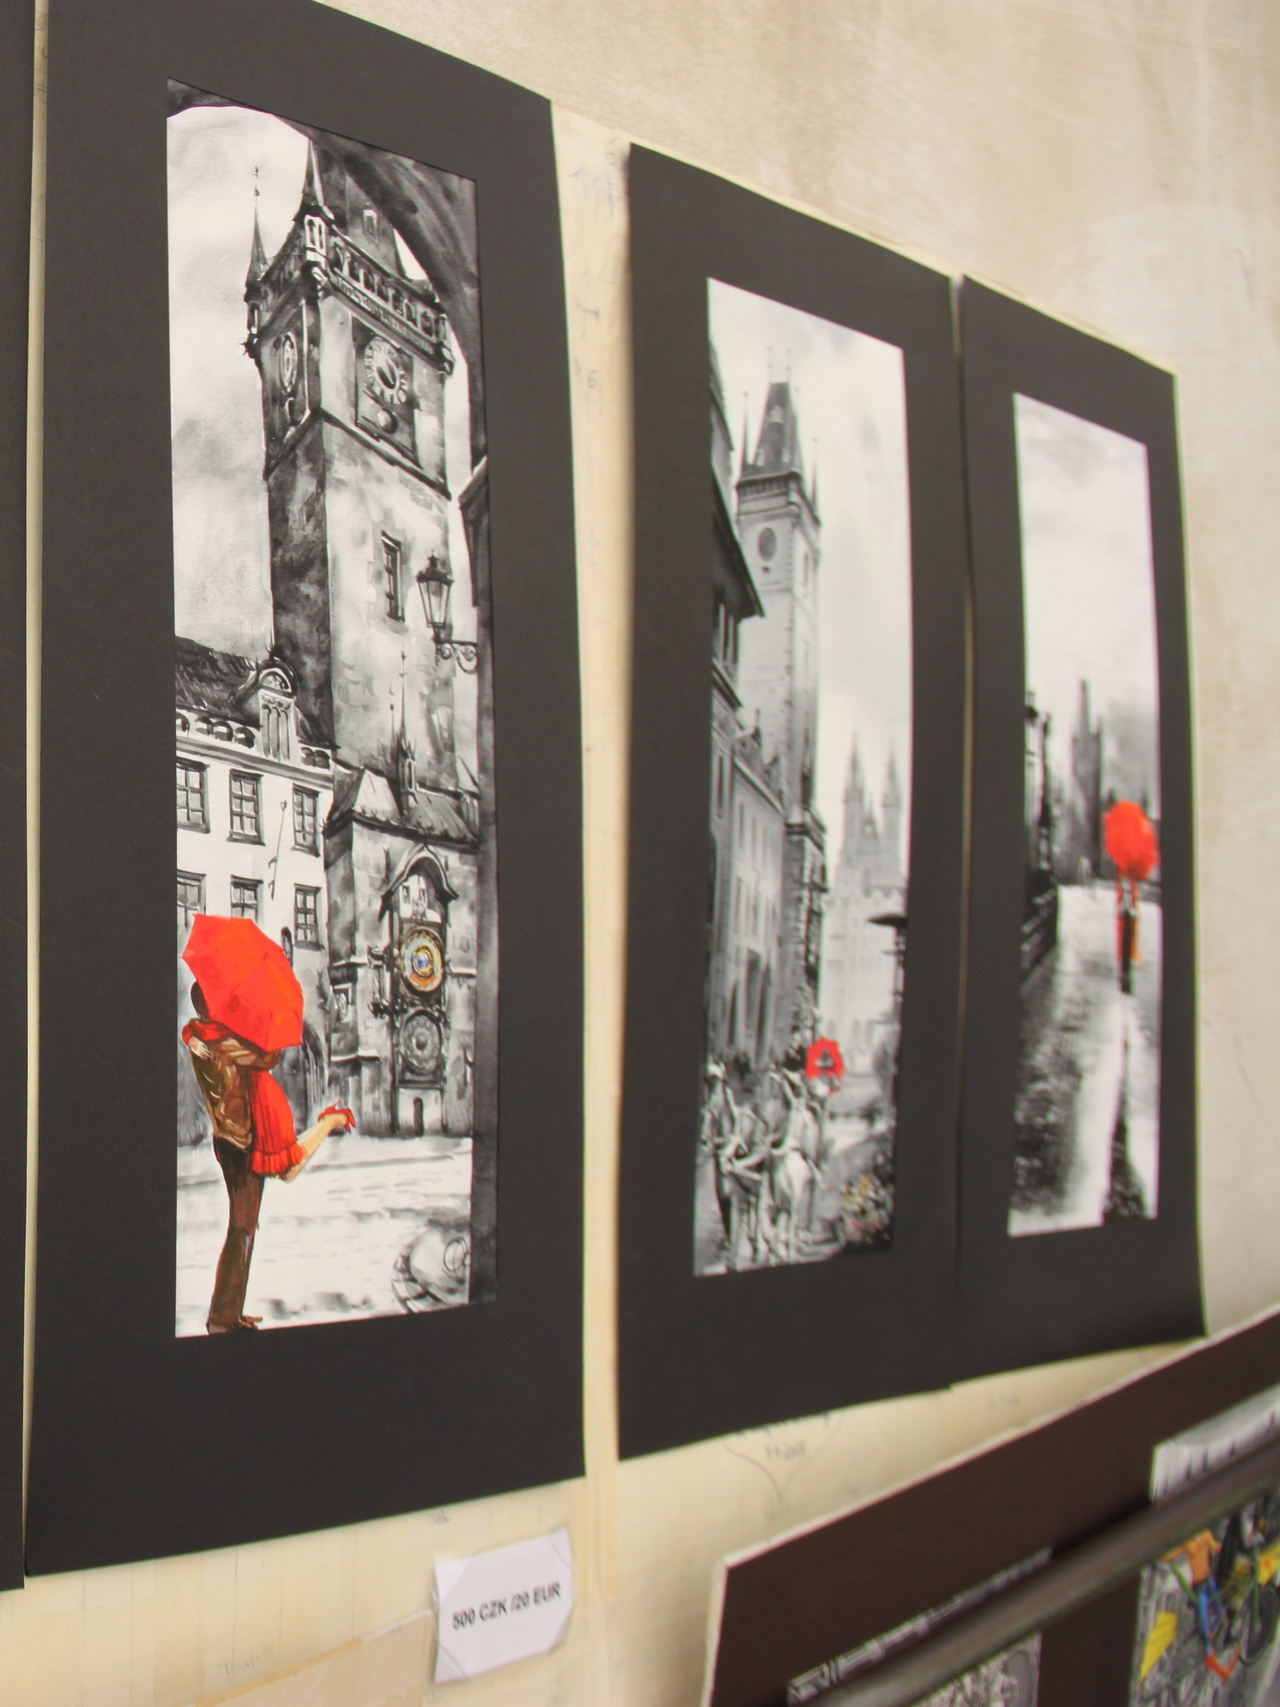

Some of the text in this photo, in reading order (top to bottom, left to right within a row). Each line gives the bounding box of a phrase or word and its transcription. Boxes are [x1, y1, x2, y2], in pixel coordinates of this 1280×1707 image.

[452, 1607, 476, 1630] 500
[479, 1597, 508, 1621] CZK
[533, 1581, 561, 1605] EUR
